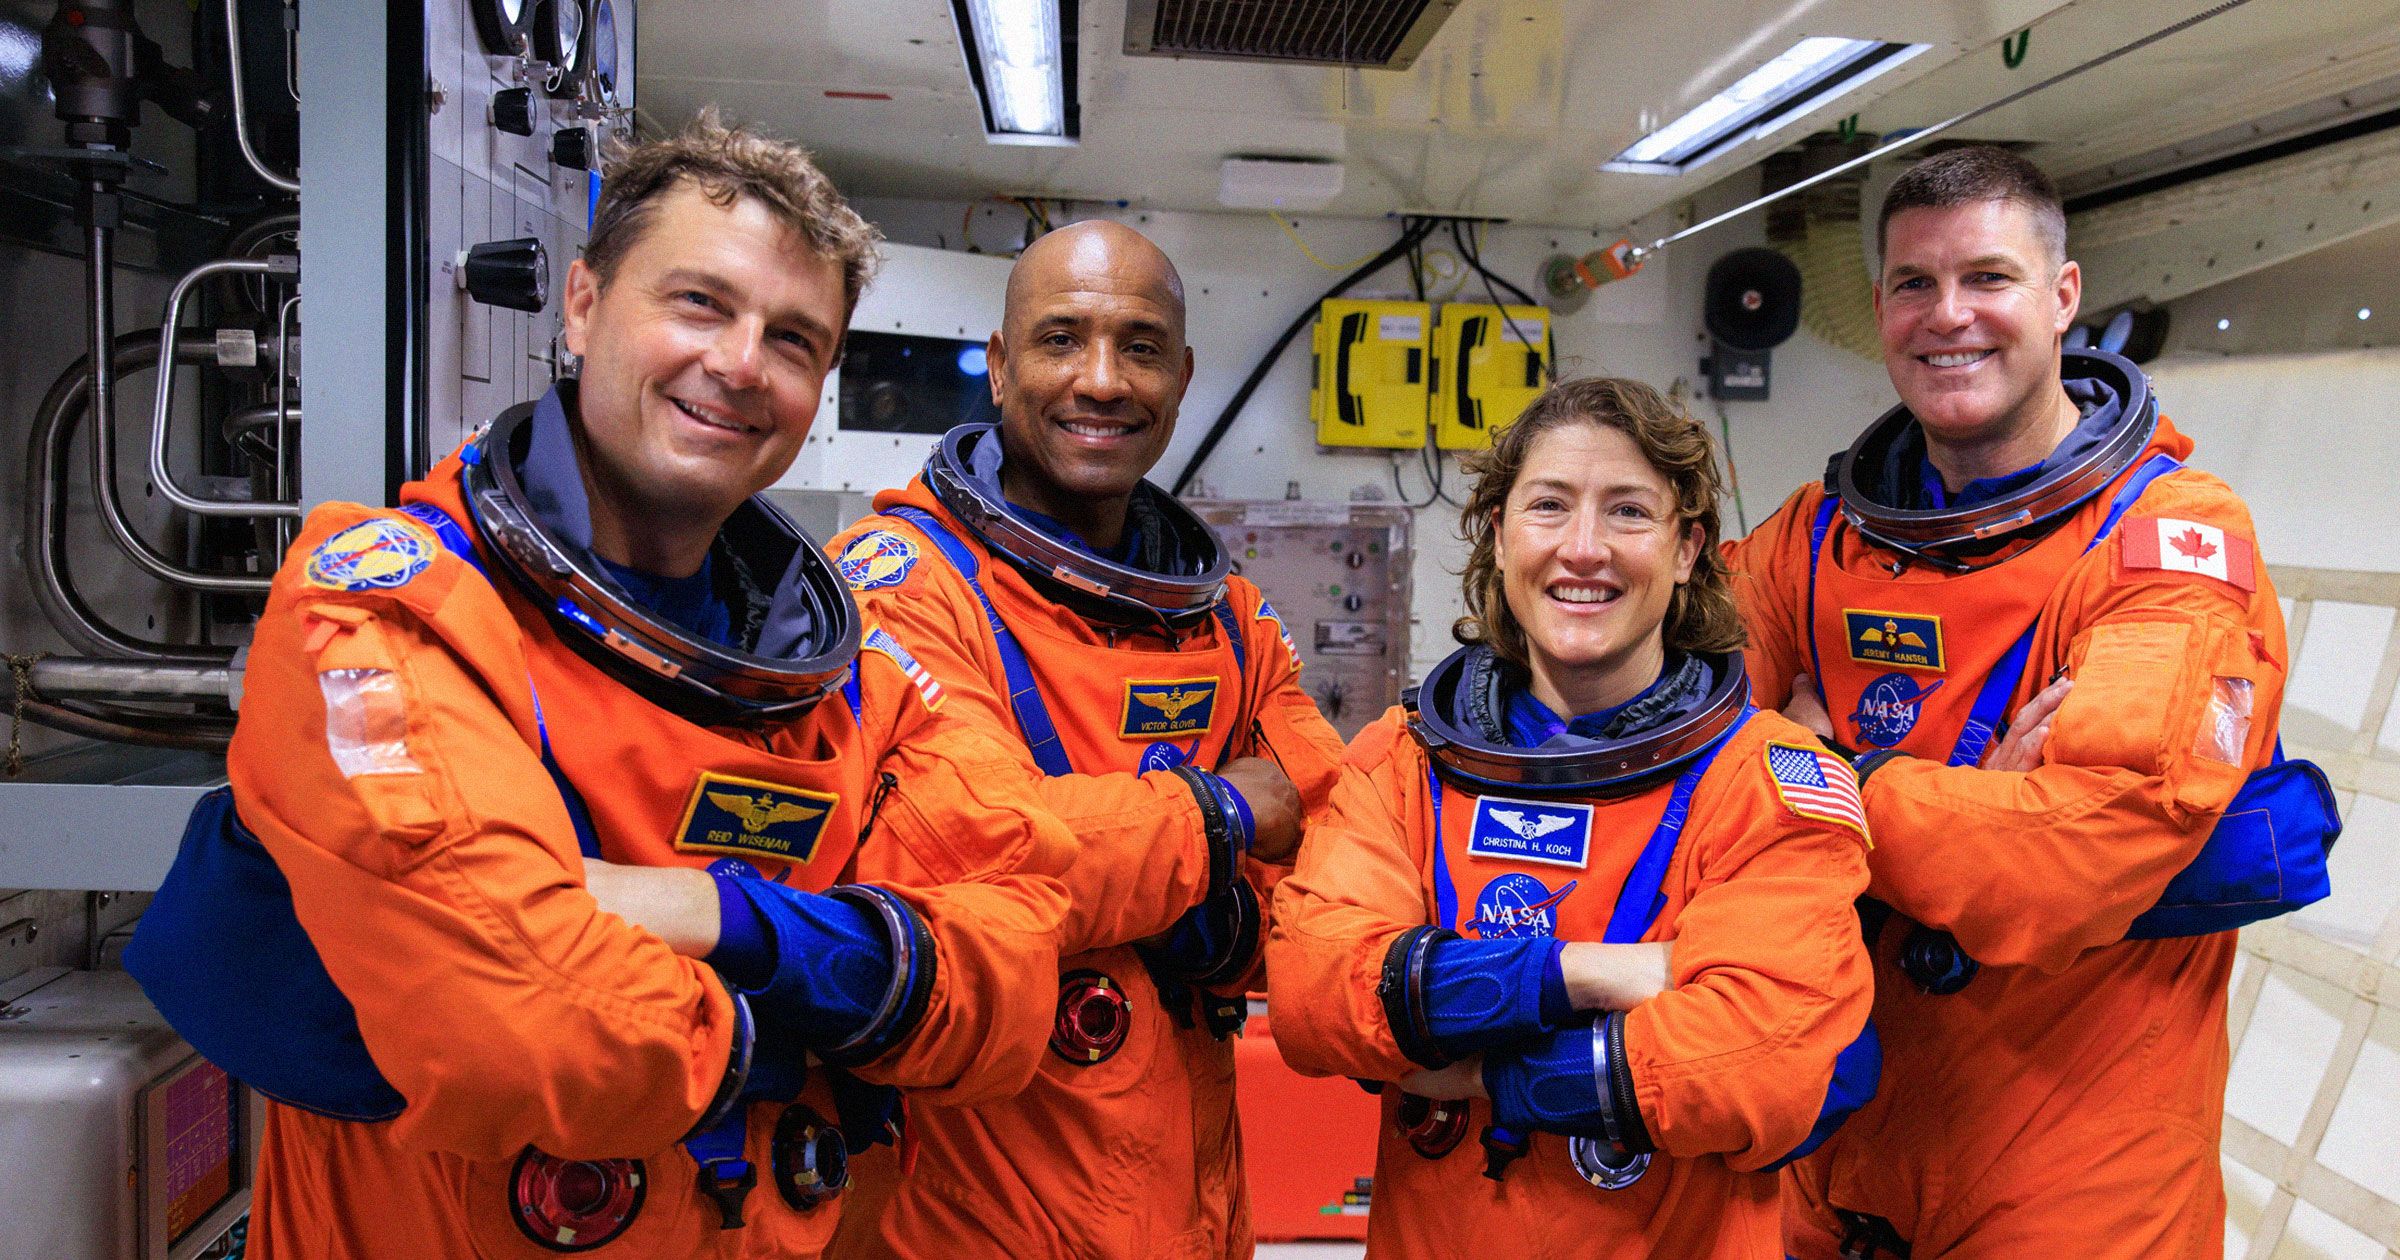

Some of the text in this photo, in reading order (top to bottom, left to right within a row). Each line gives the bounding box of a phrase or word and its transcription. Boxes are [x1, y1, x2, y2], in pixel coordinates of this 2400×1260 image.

[1862, 648, 1928, 665] JEREMY HANSEN
[1862, 698, 1915, 721] NASA
[1141, 719, 1197, 731] VICTOR GLOVER
[707, 830, 792, 851] REID WISEMAN
[1482, 836, 1571, 856] CHRISTINA H. KOCH
[1481, 903, 1551, 929] NASA
